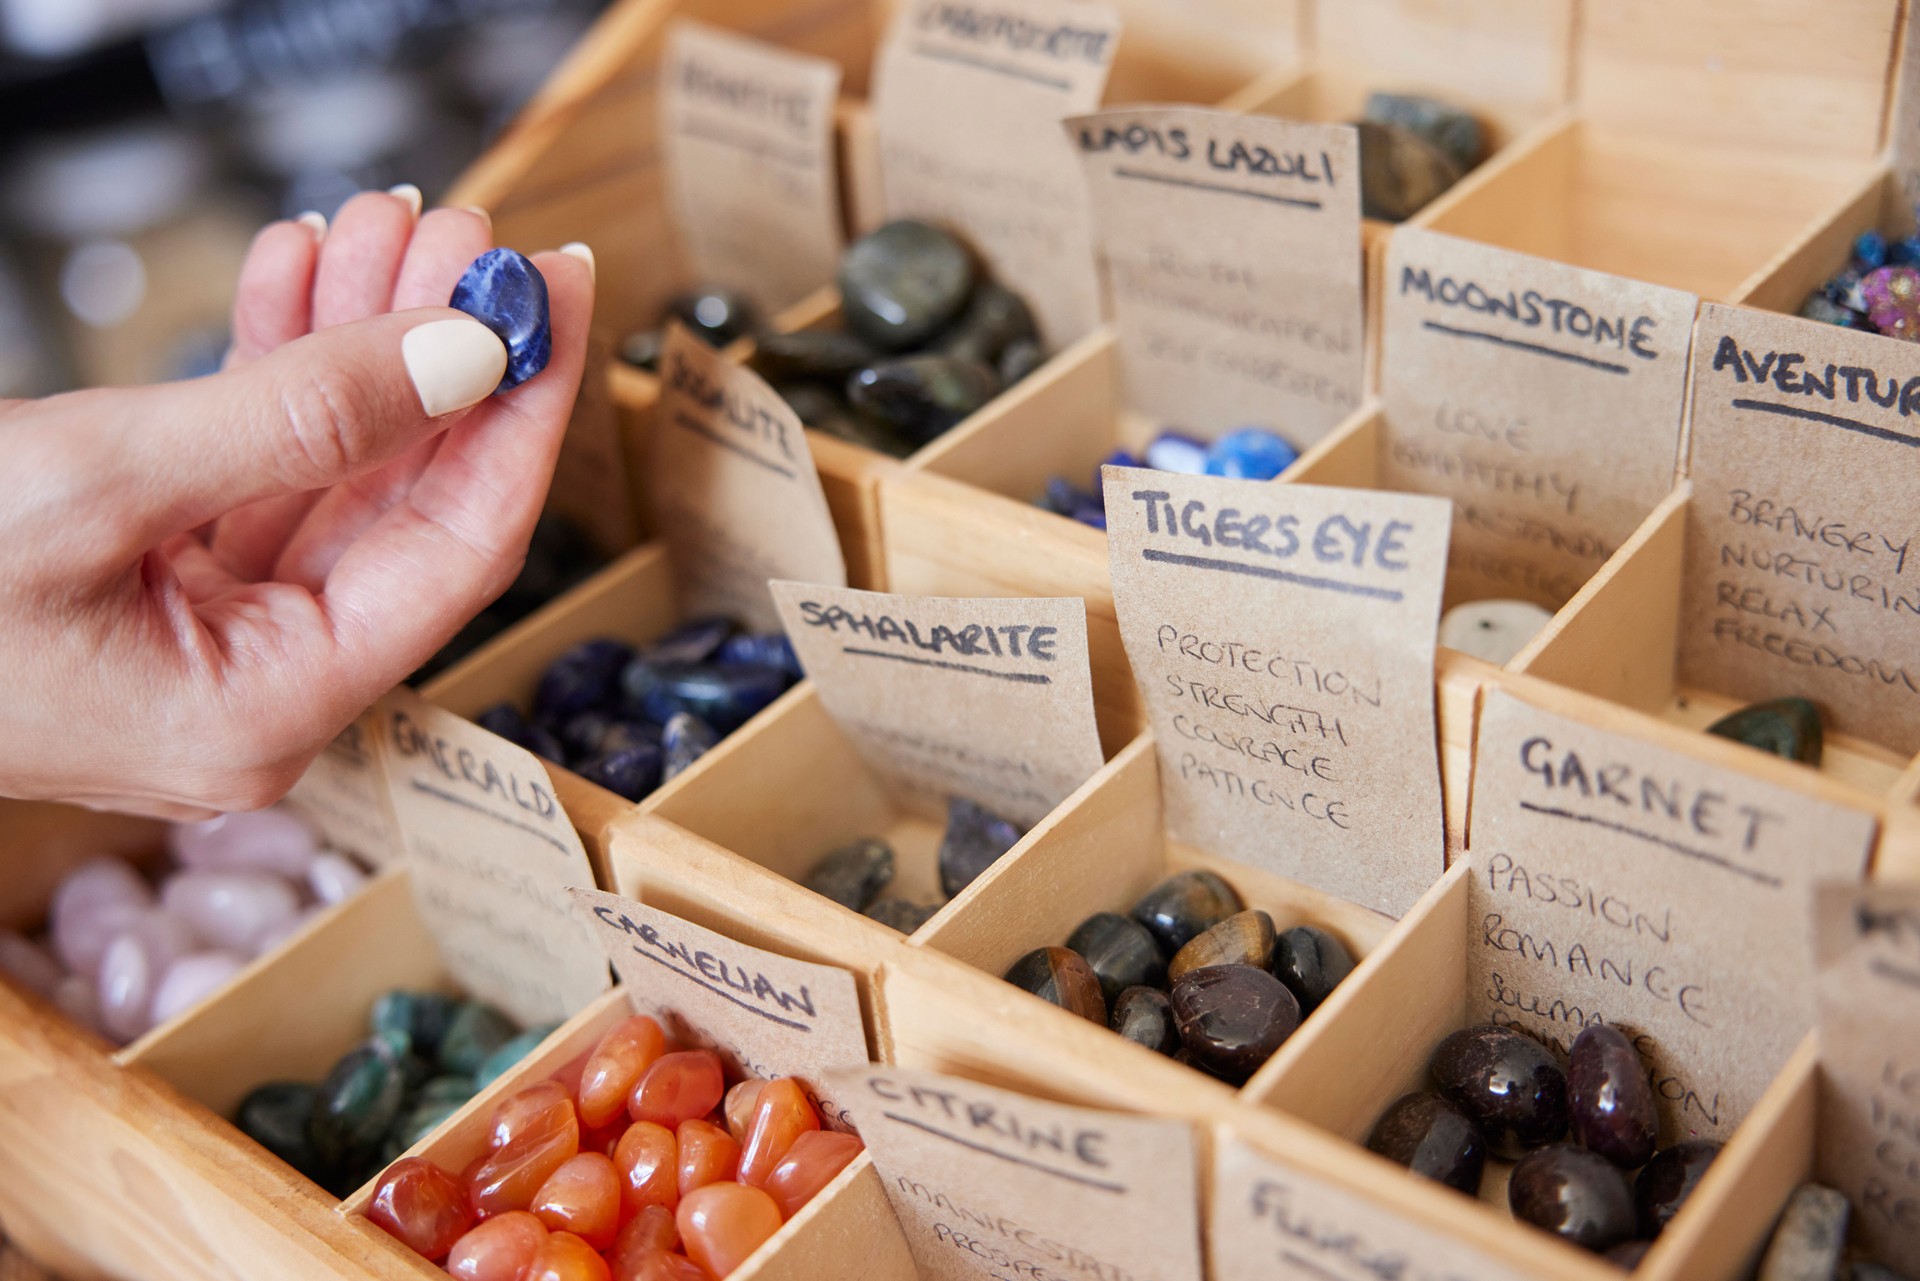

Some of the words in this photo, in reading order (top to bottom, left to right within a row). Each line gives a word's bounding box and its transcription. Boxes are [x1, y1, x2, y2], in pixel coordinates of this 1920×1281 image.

[1208, 139, 1336, 187] LAZULI
[1400, 265, 1659, 361] MOONSTONE
[1132, 489, 1300, 559] TIGERS
[1312, 513, 1413, 571] EYE
[1729, 489, 1910, 575] BRAVERY
[799, 600, 1058, 662] SPHALARITE
[1716, 580, 1838, 634] RELAX
[1157, 624, 1382, 708] PROTECTION
[1713, 617, 1919, 695] FREEDOM
[1166, 674, 1349, 748] STRENGTH
[1173, 714, 1337, 782] COURAGE
[393, 710, 557, 820] EMERALD
[1519, 735, 1786, 852] GARNET
[1488, 852, 1672, 943] PASSION
[592, 905, 817, 1018] CARNELIAN
[1483, 913, 1714, 1029] ROMANCE
[867, 1076, 1107, 1168] CITRINE
[933, 1222, 1052, 1281] PROSPE
